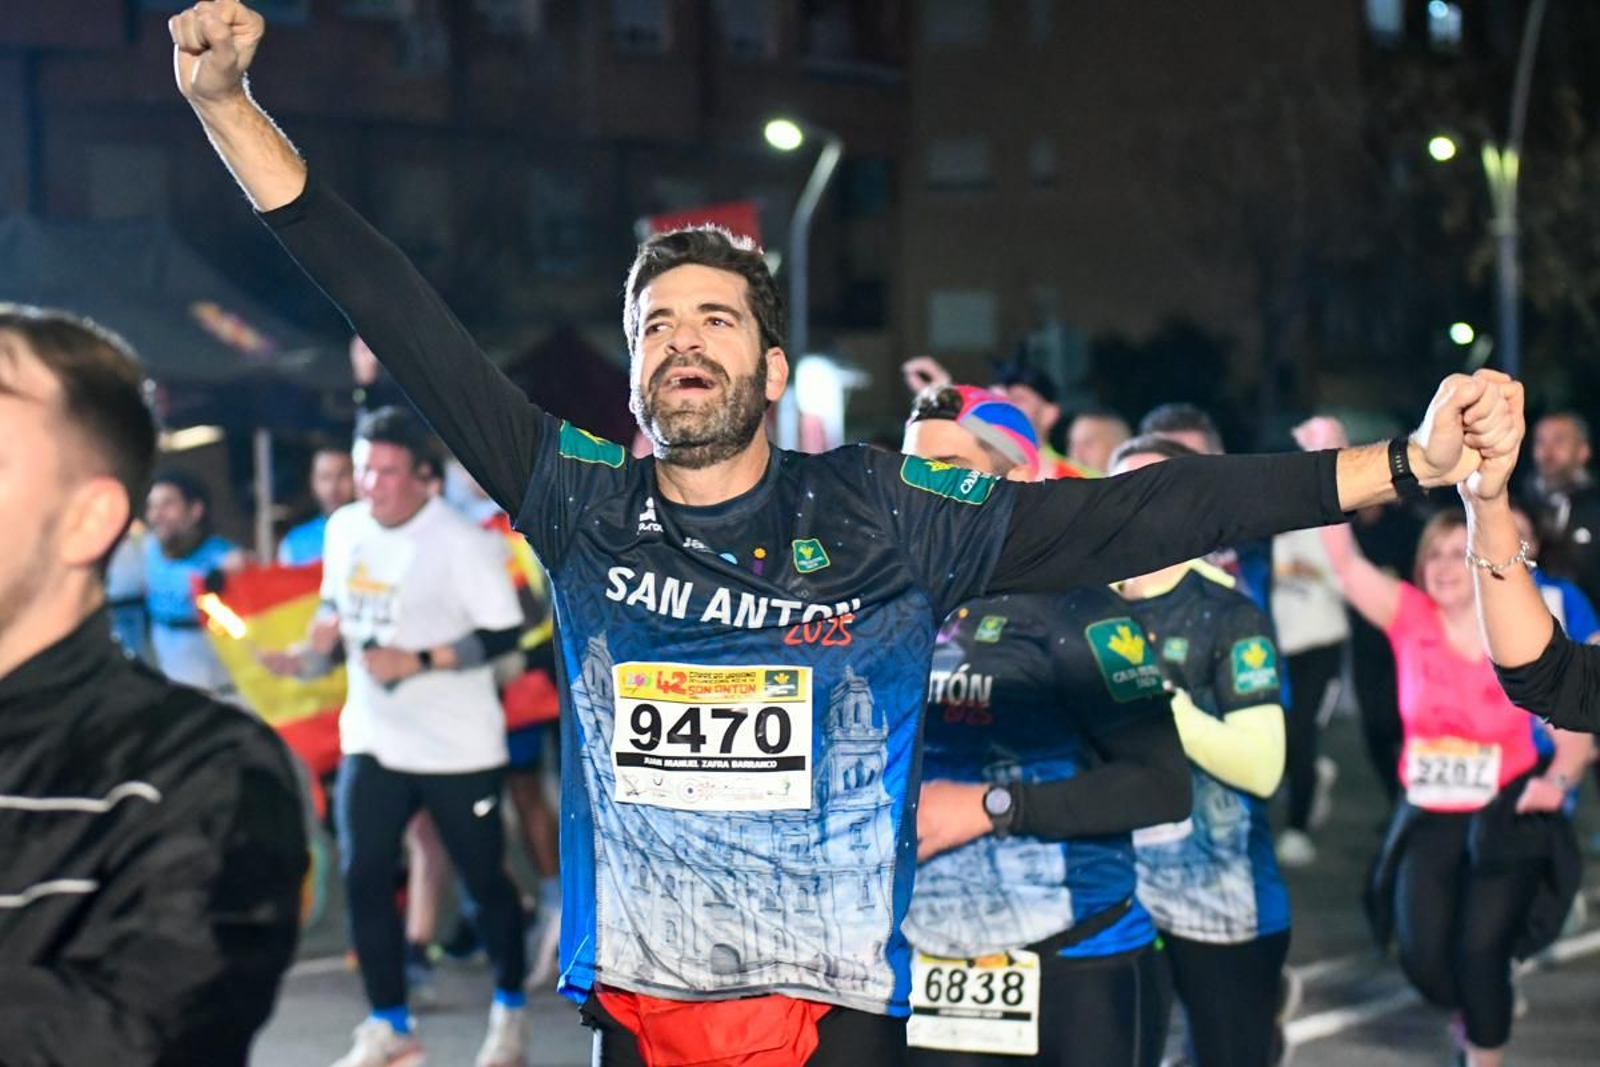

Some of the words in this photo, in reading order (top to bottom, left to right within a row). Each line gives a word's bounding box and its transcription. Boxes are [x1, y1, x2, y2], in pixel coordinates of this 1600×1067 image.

[605, 567, 693, 619] SAN
[783, 613, 856, 645] 2025
[656, 671, 688, 695] 42
[629, 703, 792, 755] 9470
[701, 760, 729, 769] ZAFRA
[731, 760, 777, 769] BARRANCO
[925, 967, 1024, 1007] 6838
